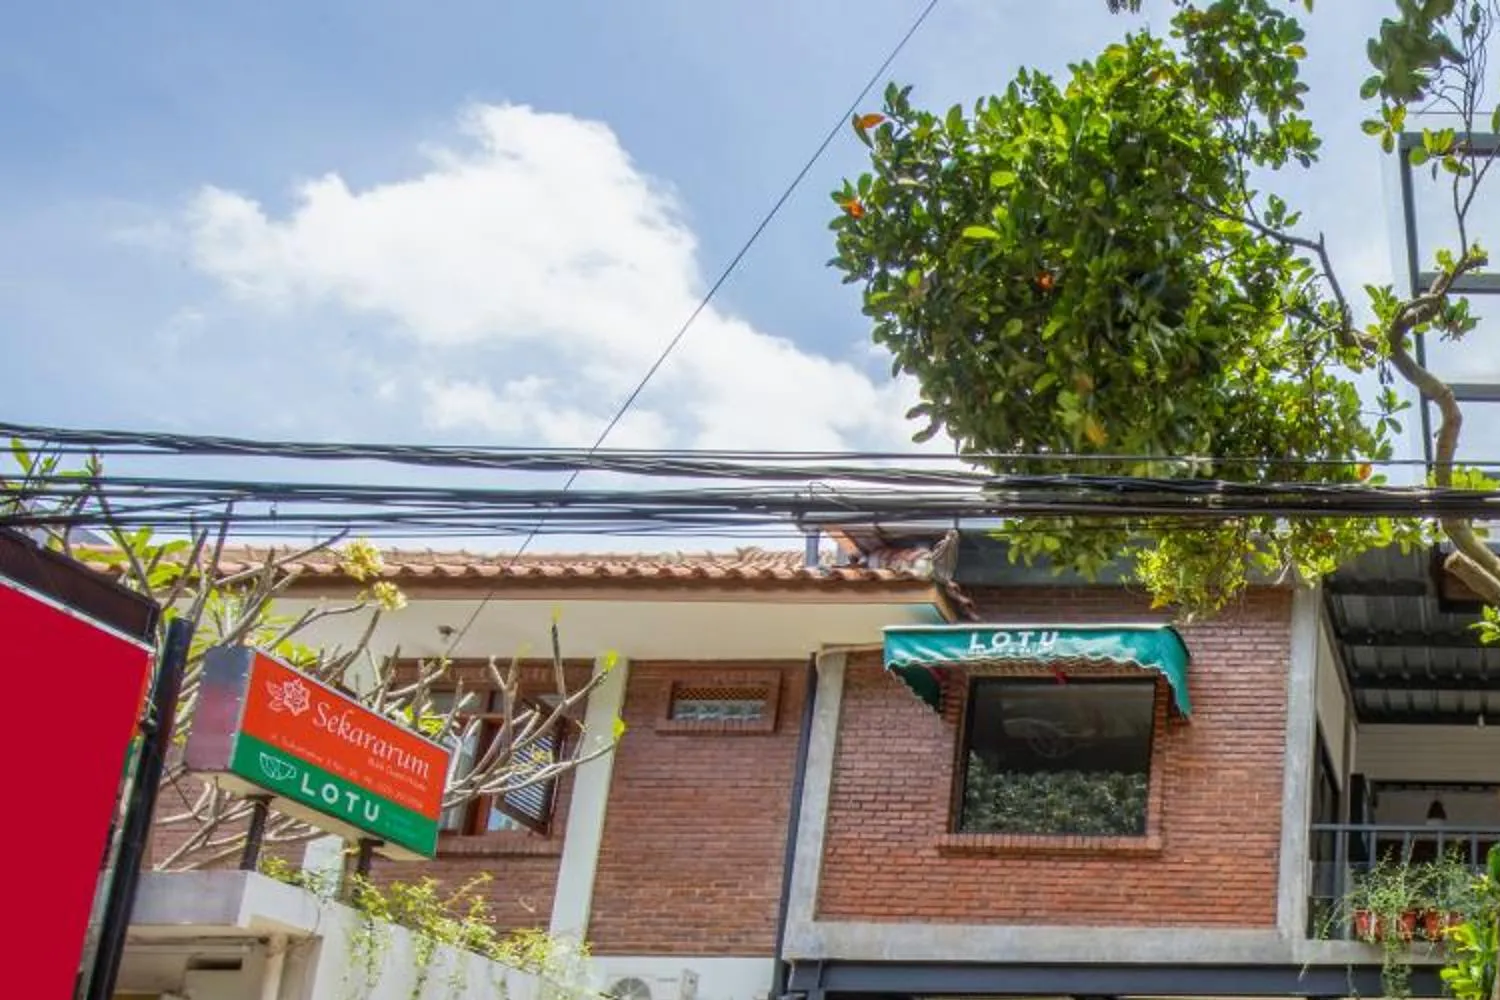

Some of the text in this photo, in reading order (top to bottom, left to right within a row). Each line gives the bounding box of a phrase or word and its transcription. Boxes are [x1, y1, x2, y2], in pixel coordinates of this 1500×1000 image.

[970, 631, 1059, 649] LOTU
[313, 700, 429, 779] Sekararum
[300, 772, 380, 822] LOTU
